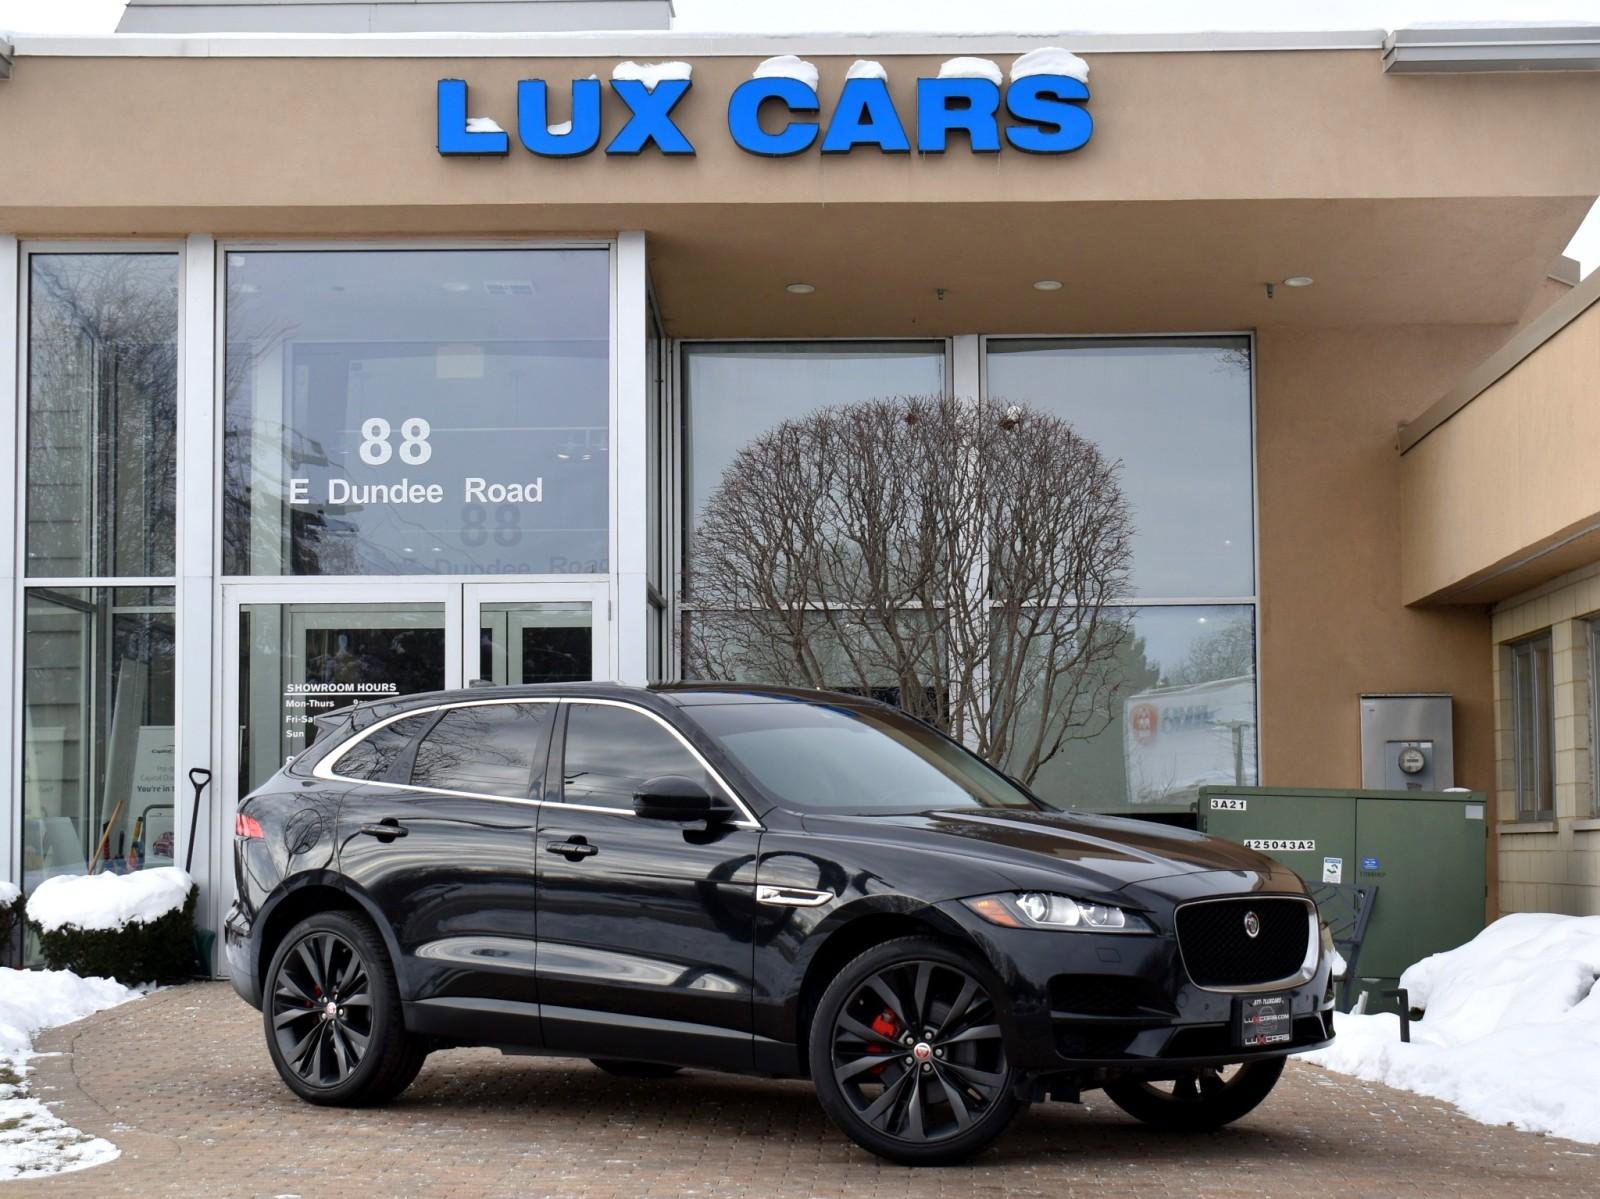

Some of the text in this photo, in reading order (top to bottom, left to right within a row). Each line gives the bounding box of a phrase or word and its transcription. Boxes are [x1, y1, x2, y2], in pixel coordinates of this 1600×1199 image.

[437, 74, 1094, 157] LUX CARS
[359, 417, 433, 466] 88
[289, 477, 543, 504] E Dundee Road
[287, 683, 397, 692] SHOWROOM HOURS
[286, 699, 335, 708] Mon-Thurs
[286, 730, 304, 738] Sun
[1211, 800, 1245, 809] 3A21
